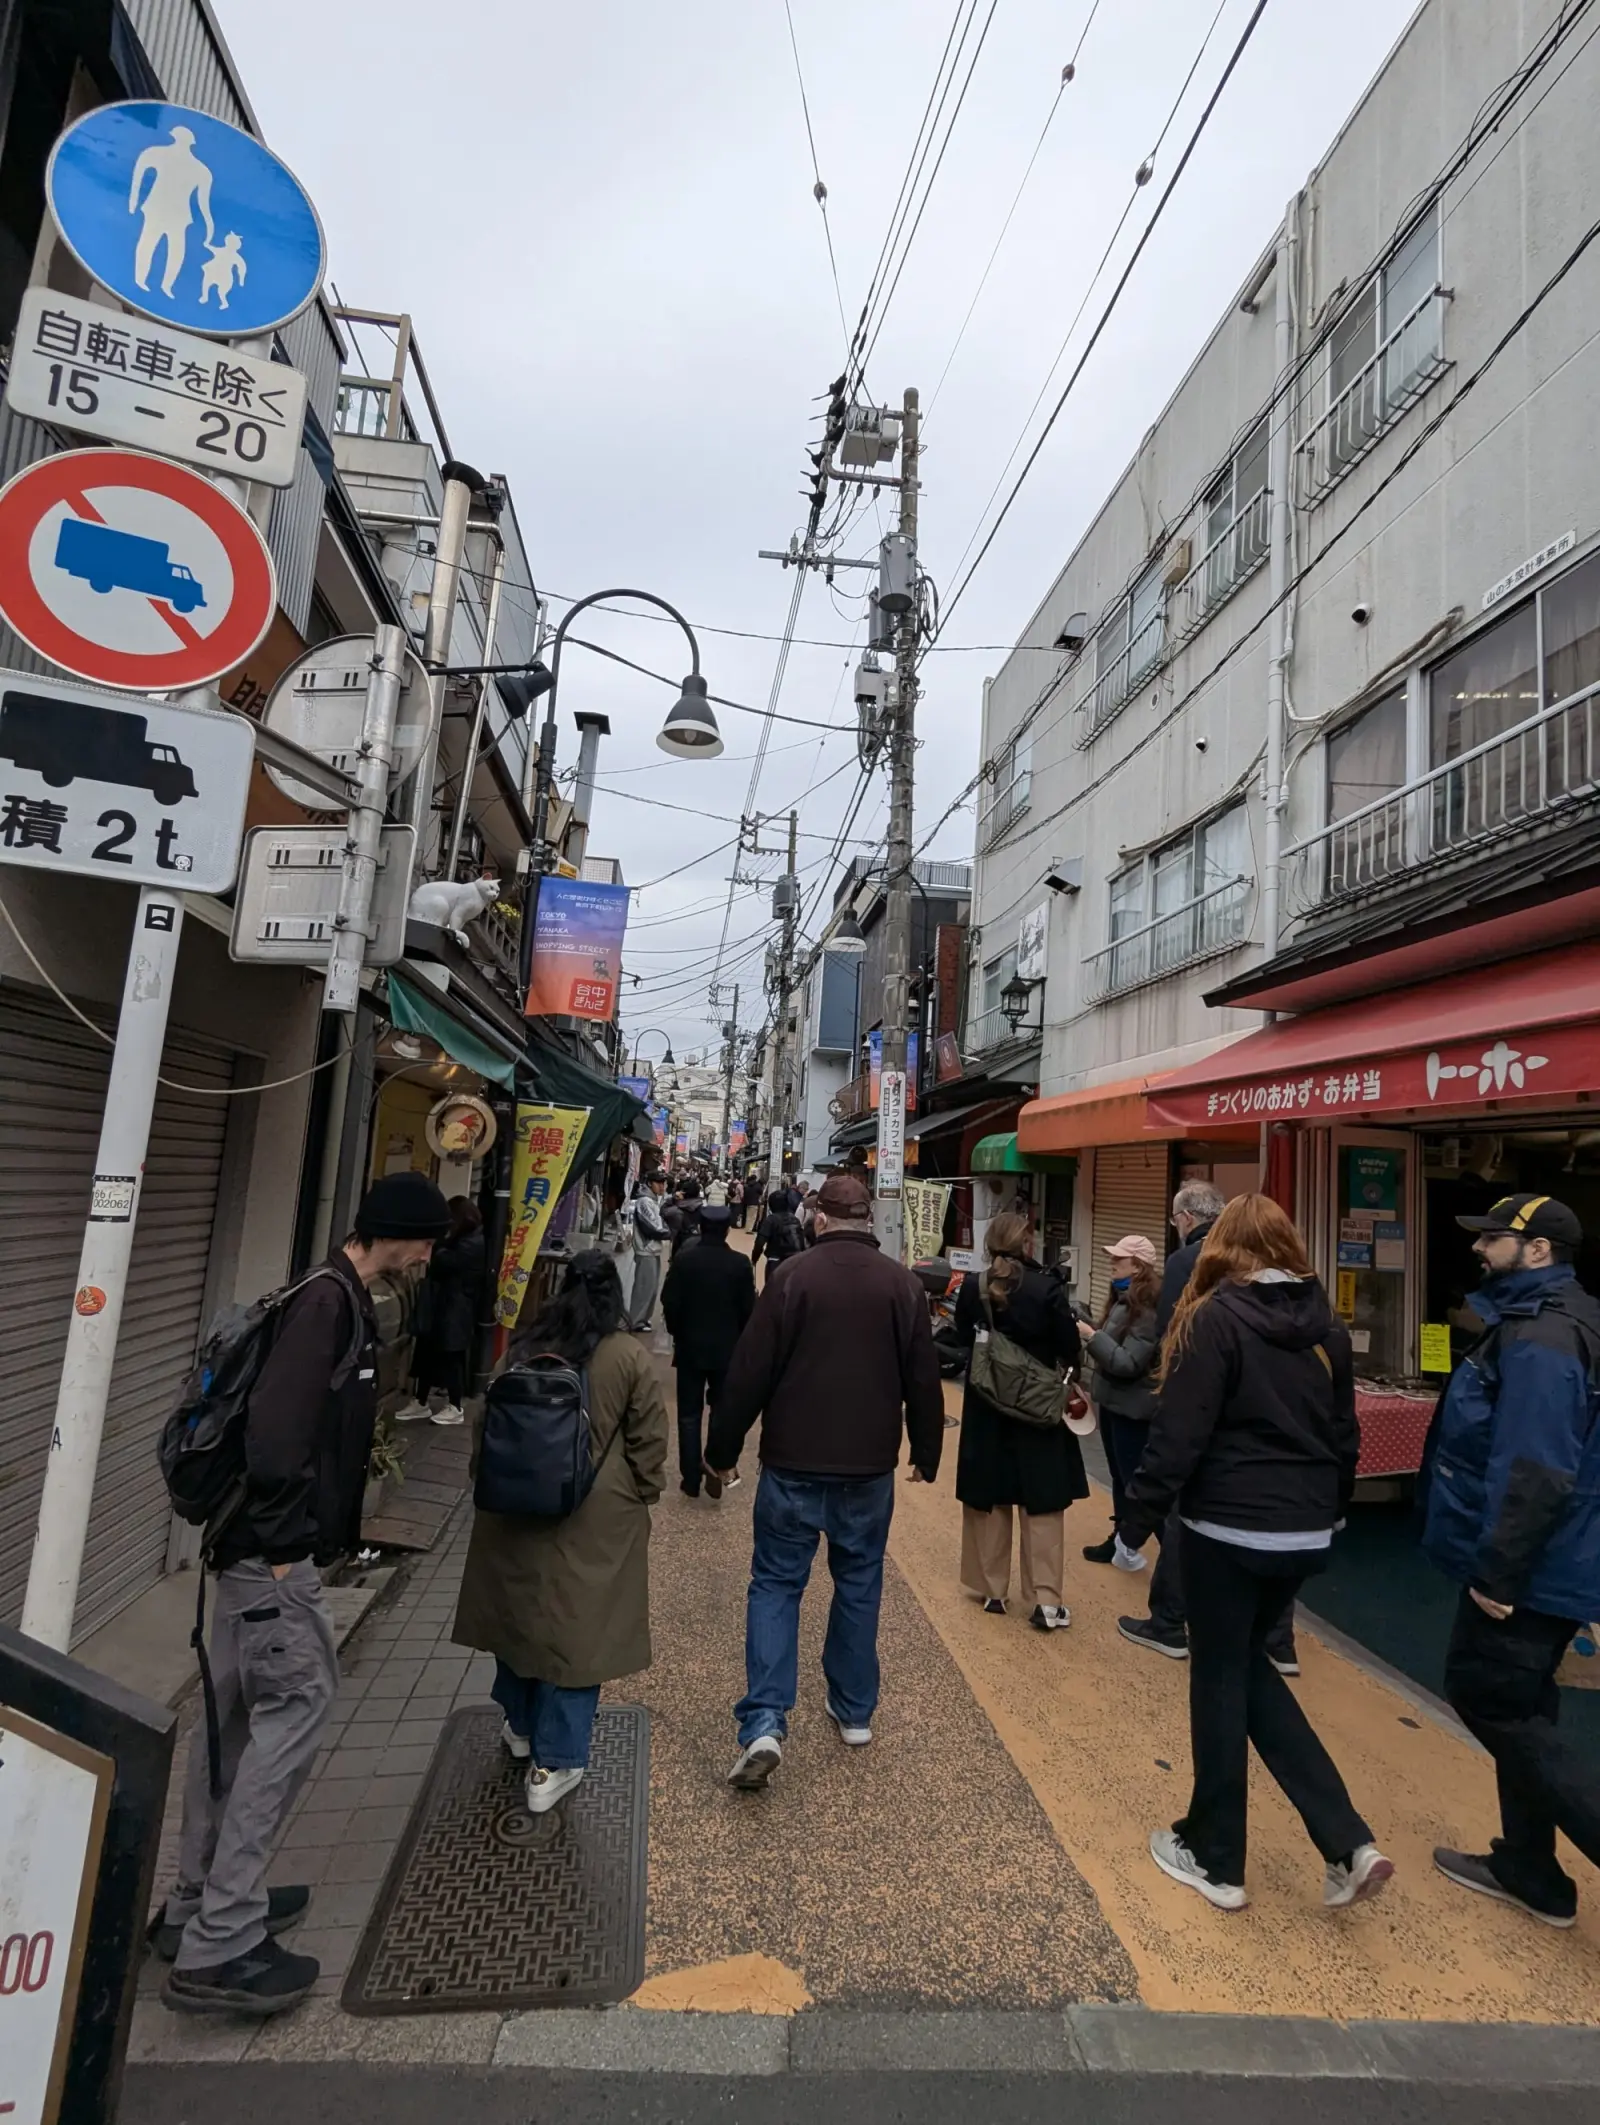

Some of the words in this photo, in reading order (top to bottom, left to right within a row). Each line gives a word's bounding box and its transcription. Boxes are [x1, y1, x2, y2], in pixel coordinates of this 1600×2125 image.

[37, 309, 288, 419] 自転車を除く
[48, 363, 99, 416] 15
[195, 411, 267, 463] 20
[540, 911, 567, 920] TOKYO
[537, 927, 569, 935] YANAKA
[536, 942, 575, 951] SHOPPING
[578, 944, 611, 955] STREET
[576, 984, 606, 998] 谷中
[573, 996, 605, 1012] ぎんざ
[1426, 1040, 1549, 1101] トーホー
[1207, 1069, 1381, 1118] 手づくりのおかず・お弁当
